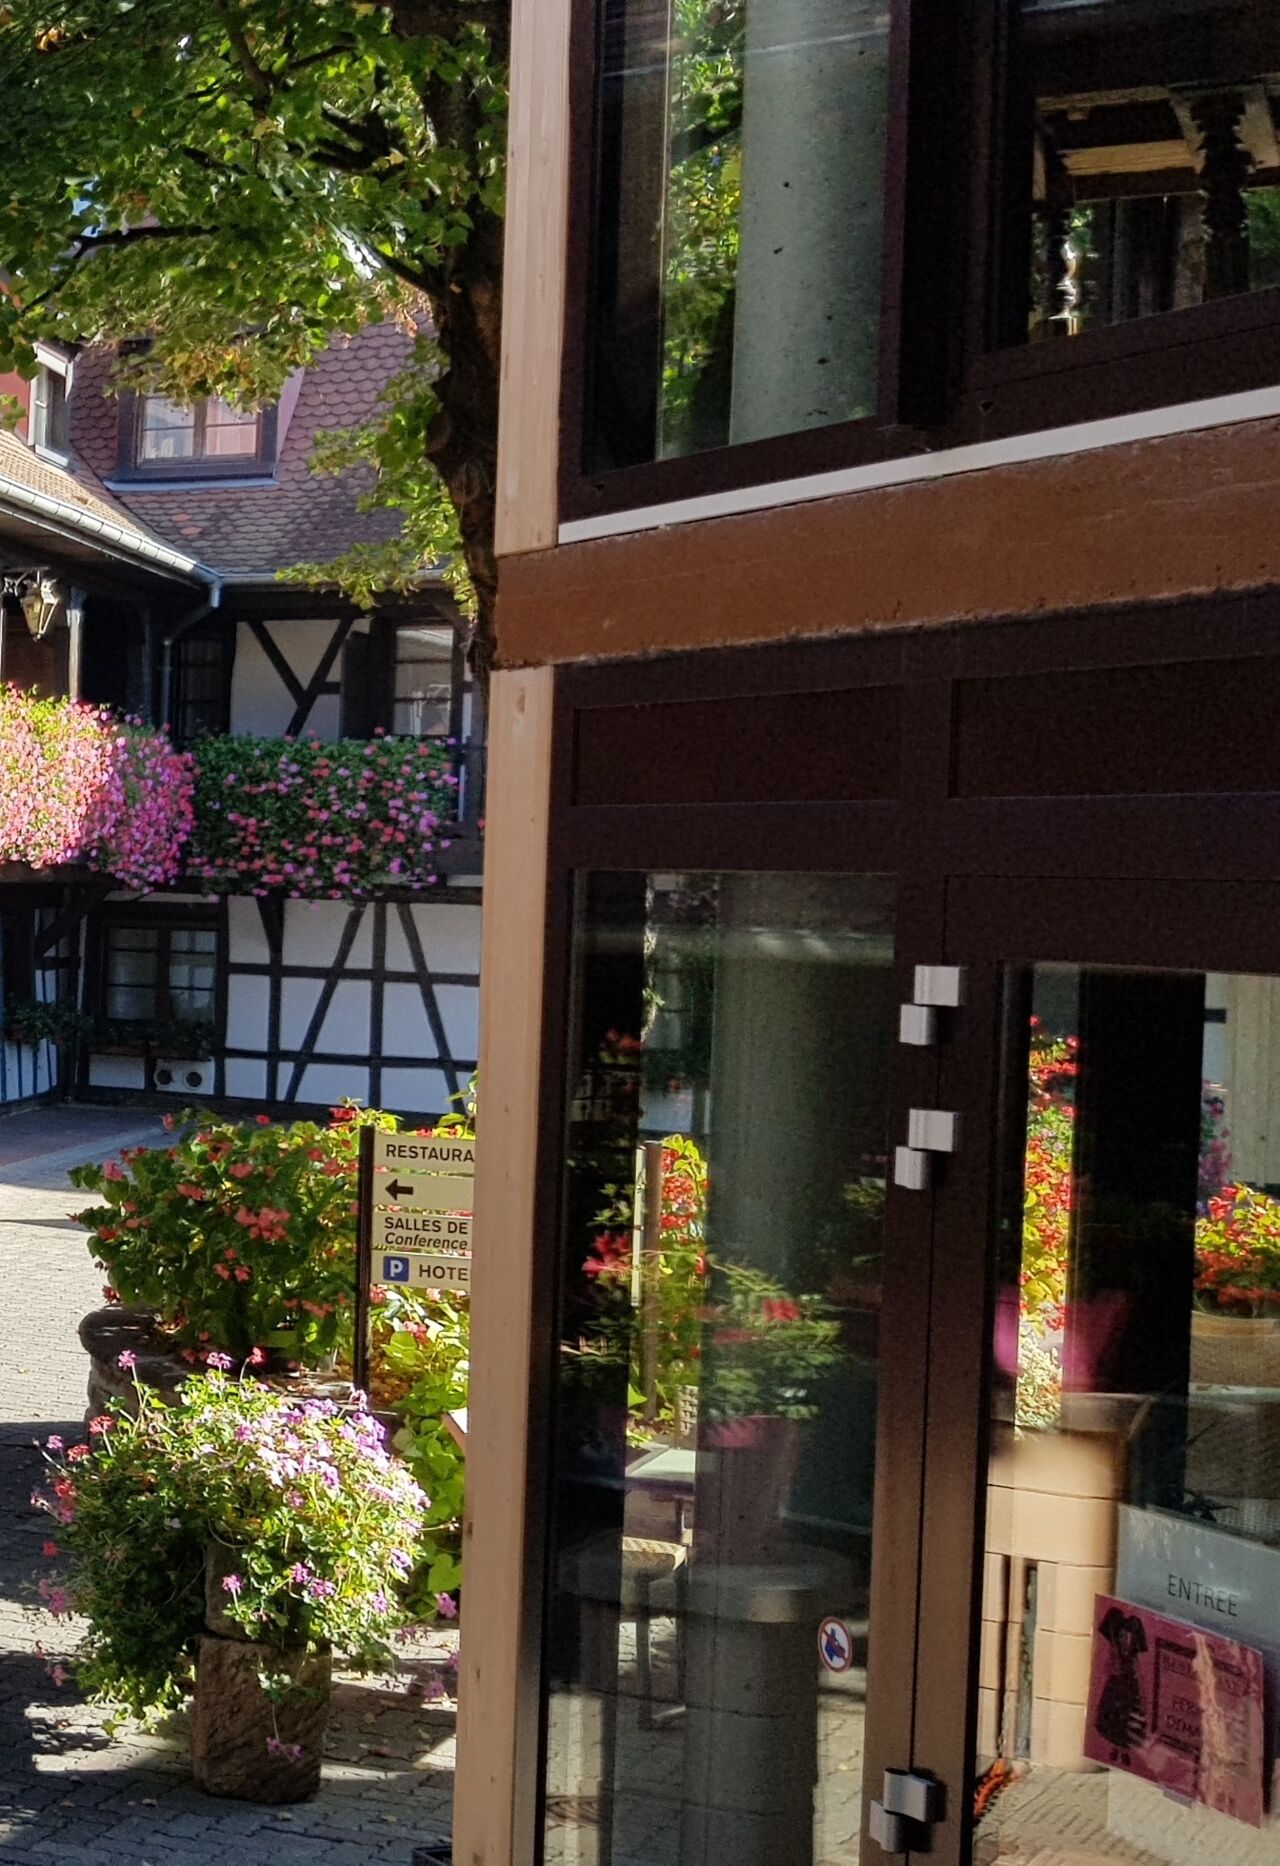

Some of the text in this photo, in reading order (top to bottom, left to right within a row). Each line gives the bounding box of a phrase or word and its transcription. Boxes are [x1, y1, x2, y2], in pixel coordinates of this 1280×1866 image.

[384, 1216, 469, 1235] SALLES DE
[385, 1232, 468, 1250] Conference
